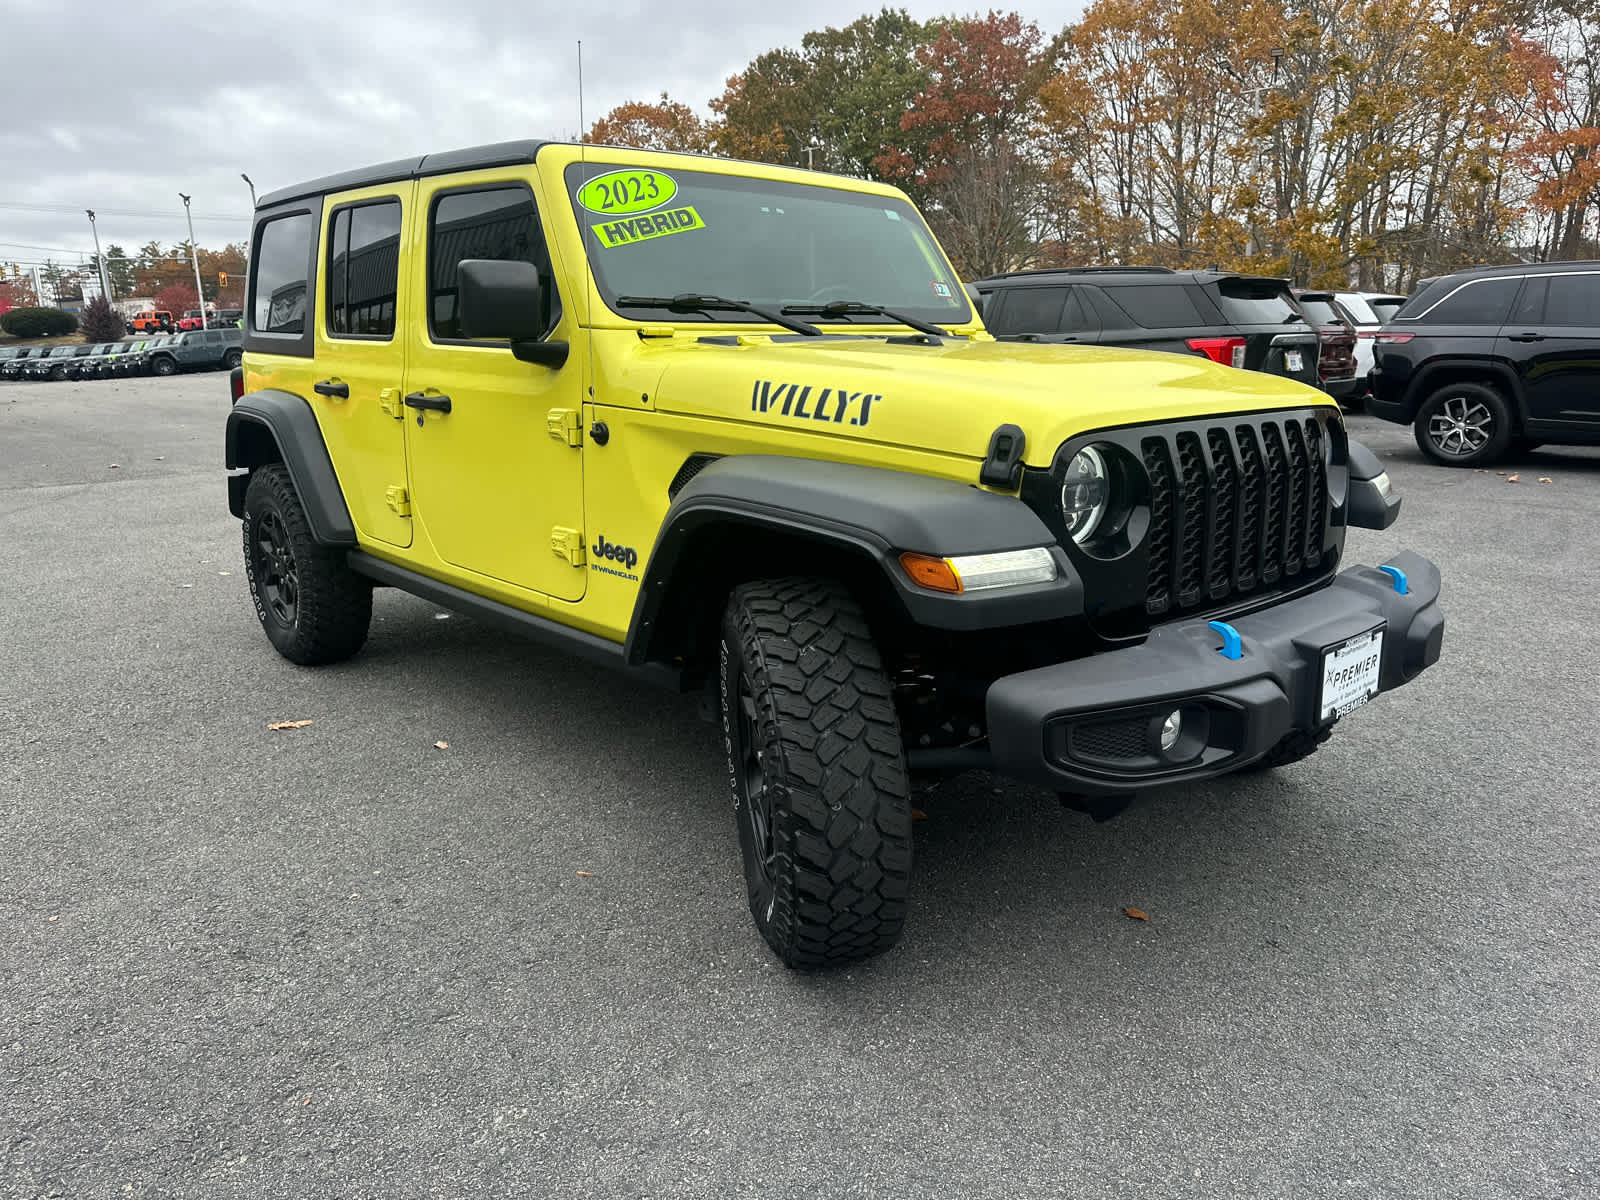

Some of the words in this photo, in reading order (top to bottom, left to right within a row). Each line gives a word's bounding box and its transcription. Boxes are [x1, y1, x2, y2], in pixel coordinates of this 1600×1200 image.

[596, 174, 660, 209] 2023
[603, 209, 696, 244] HYBRID
[751, 380, 883, 427] WILLYS
[592, 535, 637, 570] Jeep
[1333, 654, 1378, 688] PREMIER
[1336, 695, 1368, 720] PREMIER
